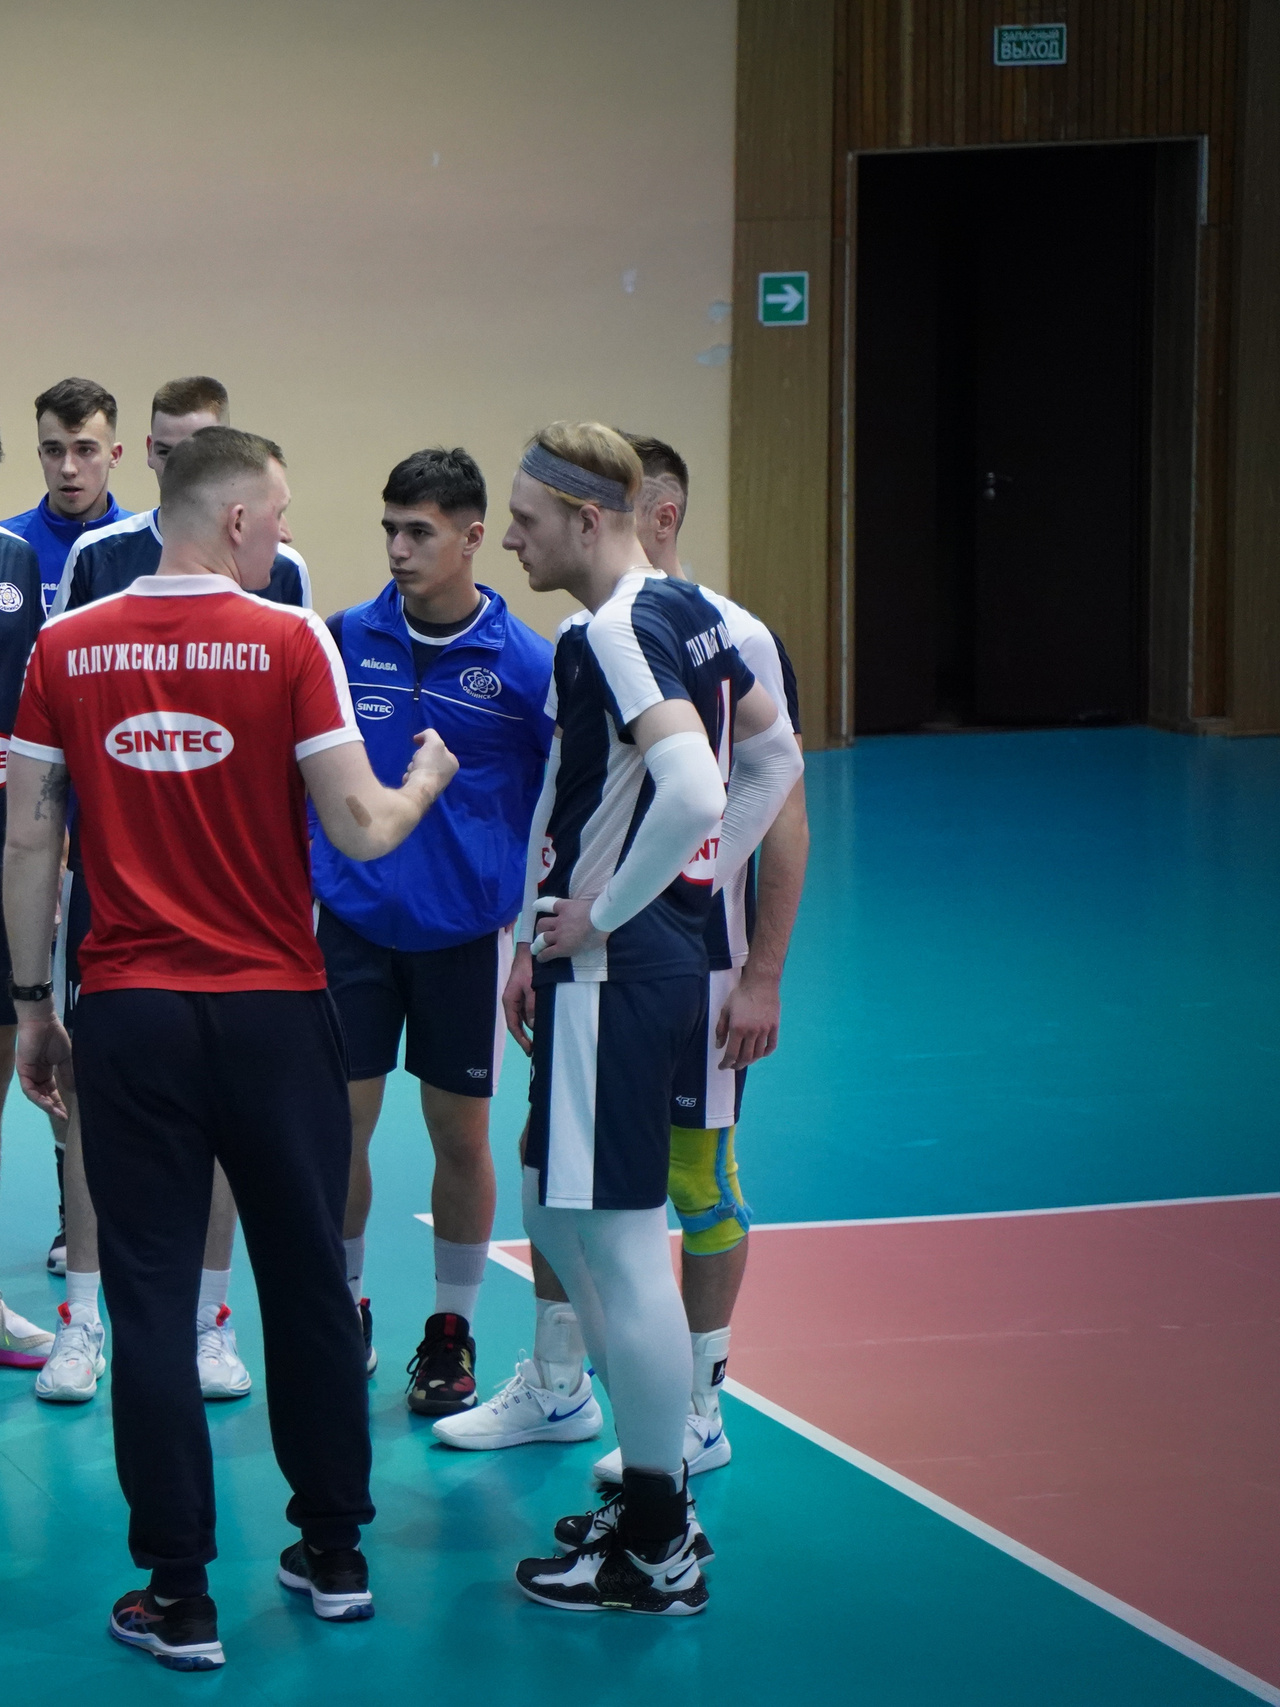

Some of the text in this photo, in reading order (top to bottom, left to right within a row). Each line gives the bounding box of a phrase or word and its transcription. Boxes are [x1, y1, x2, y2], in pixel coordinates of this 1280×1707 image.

[1001, 41, 1060, 59] ВЫХОД
[68, 642, 271, 677] КАЛУЖСКАЯ ОБЛАСТЬ
[357, 703, 392, 713] SINTEC
[114, 729, 223, 755] SINTEC
